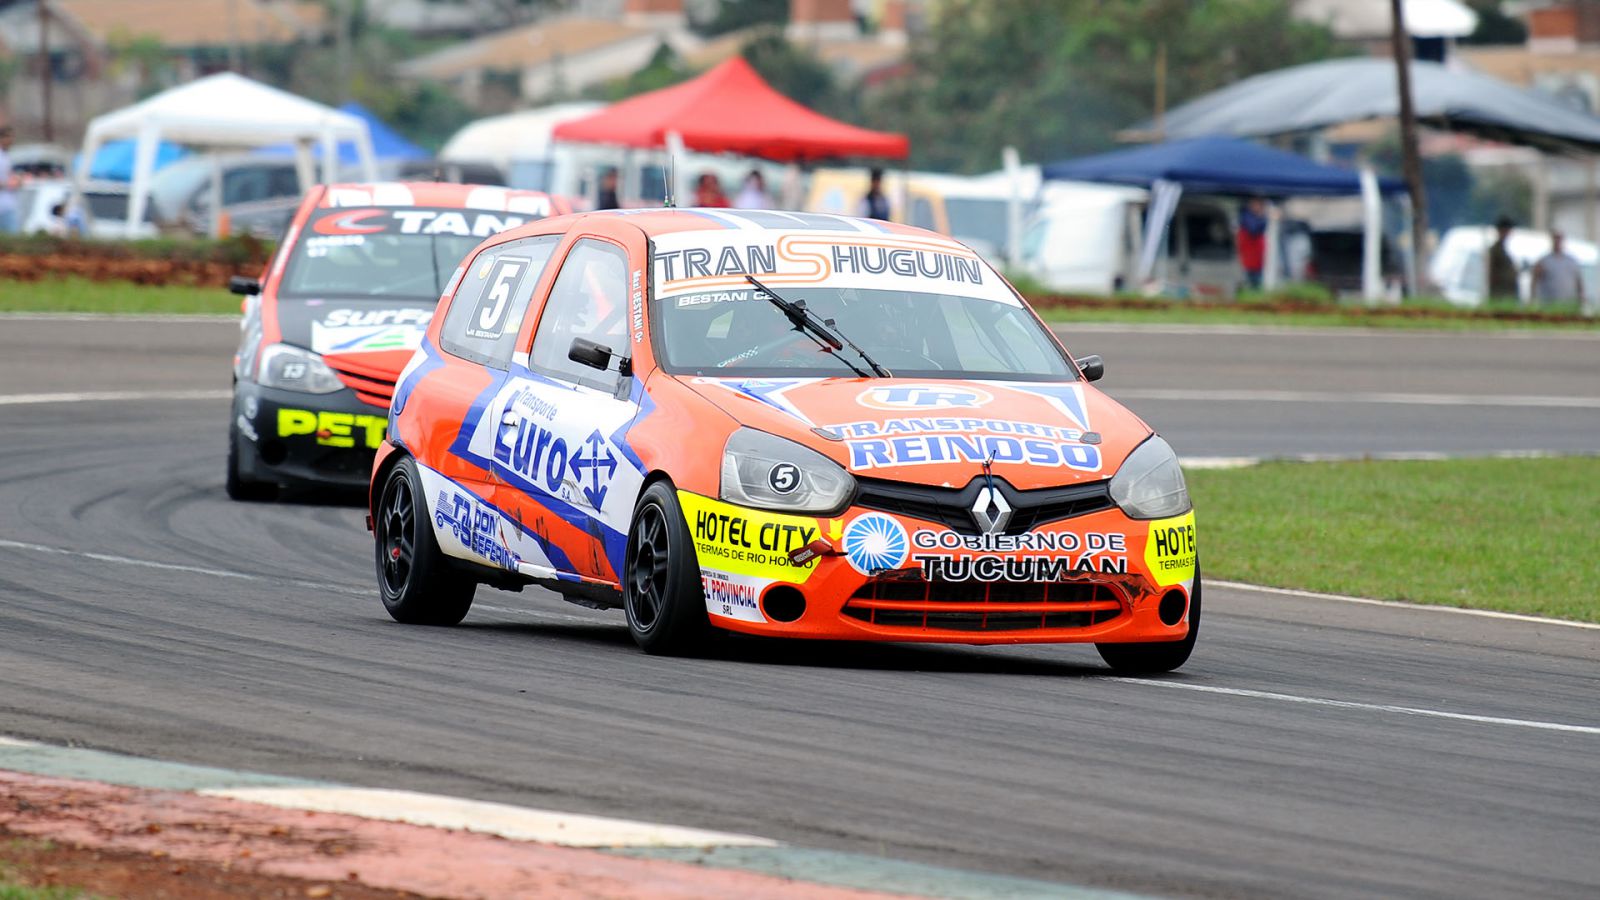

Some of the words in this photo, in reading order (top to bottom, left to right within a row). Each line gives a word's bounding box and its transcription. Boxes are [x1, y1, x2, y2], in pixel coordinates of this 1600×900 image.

[479, 263, 520, 330] 5
[632, 291, 643, 330] BESTANI
[678, 292, 748, 307] BESTANI
[518, 385, 559, 422] Transporte
[871, 387, 977, 408] TR
[493, 390, 568, 492] Euro
[826, 418, 1082, 441] TRANSPORTE
[850, 435, 1100, 469] REINOSO
[774, 467, 794, 489] 5
[474, 507, 498, 538] DON
[696, 509, 752, 548] HOTEL
[759, 522, 816, 553] CITY
[696, 542, 730, 558] TERMAS
[731, 549, 745, 561] DE
[747, 552, 767, 565] RIO
[914, 531, 1086, 552] GOBIERNO
[1087, 533, 1127, 552] DE
[914, 550, 1128, 582] TUCUMÁN
[1158, 557, 1190, 571] TERMAS
[711, 579, 757, 609] PROVINCIAL
[722, 604, 733, 616] SRL
